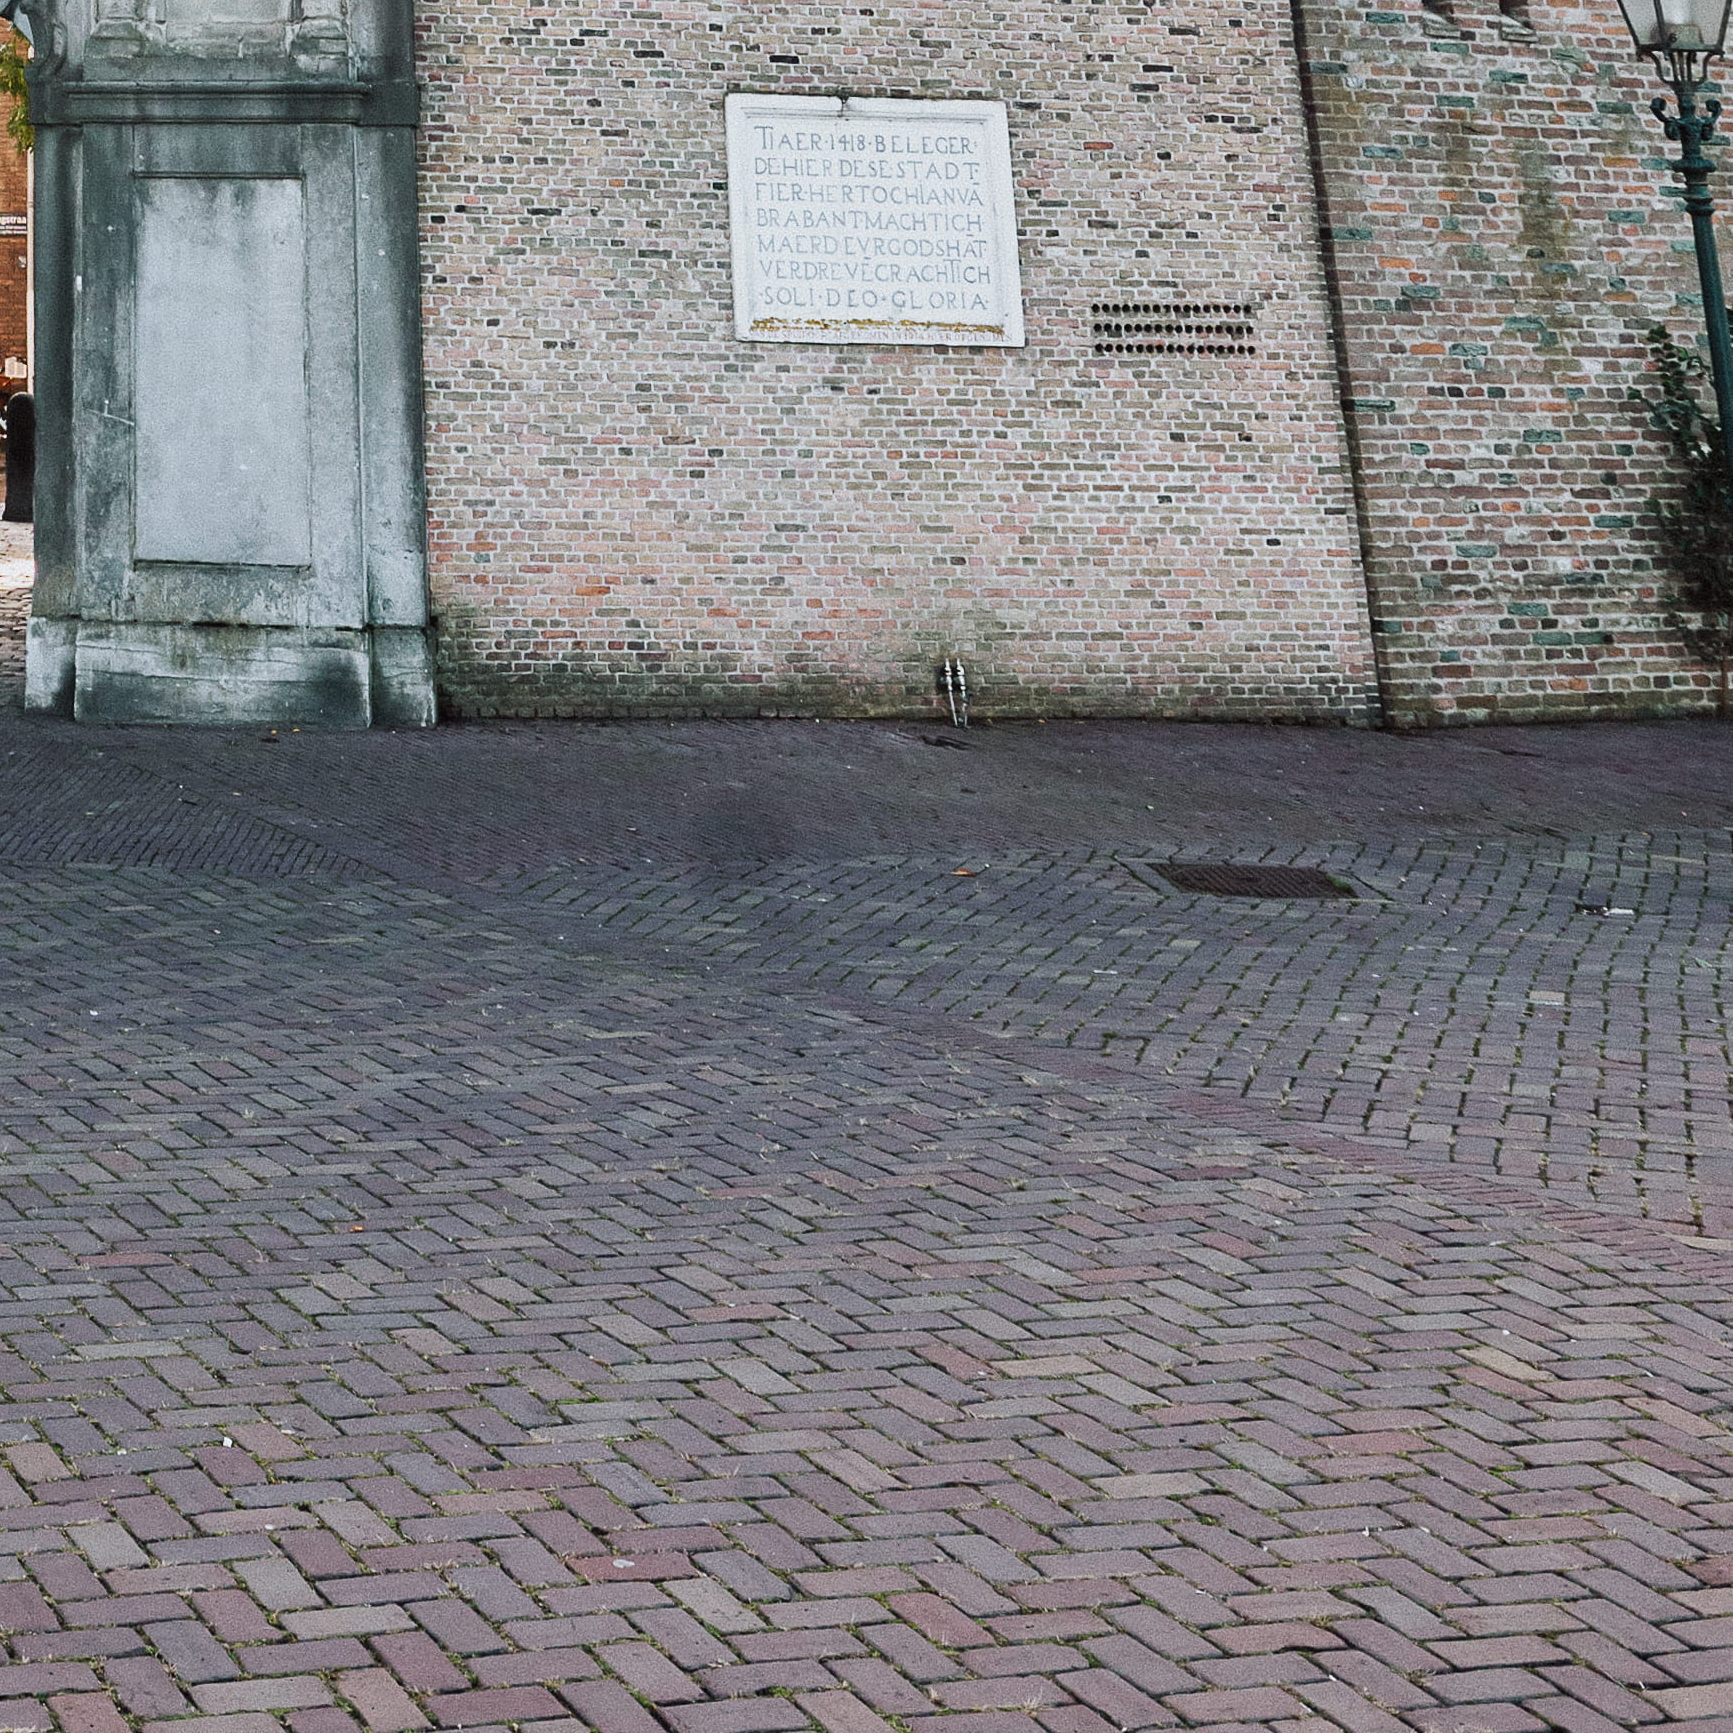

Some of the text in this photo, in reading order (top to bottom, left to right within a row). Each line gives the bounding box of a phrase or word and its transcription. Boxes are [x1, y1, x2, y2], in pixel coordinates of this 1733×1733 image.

[829, 132, 867, 152] 1418
[782, 157, 833, 177] HIER
[839, 159, 893, 179] DESE
[754, 182, 805, 203] FIER
[756, 207, 983, 233] BRABANT MACHTICH
[874, 259, 992, 285] CRACHTICH
[763, 286, 989, 311] SOLI DEO GLORIA
